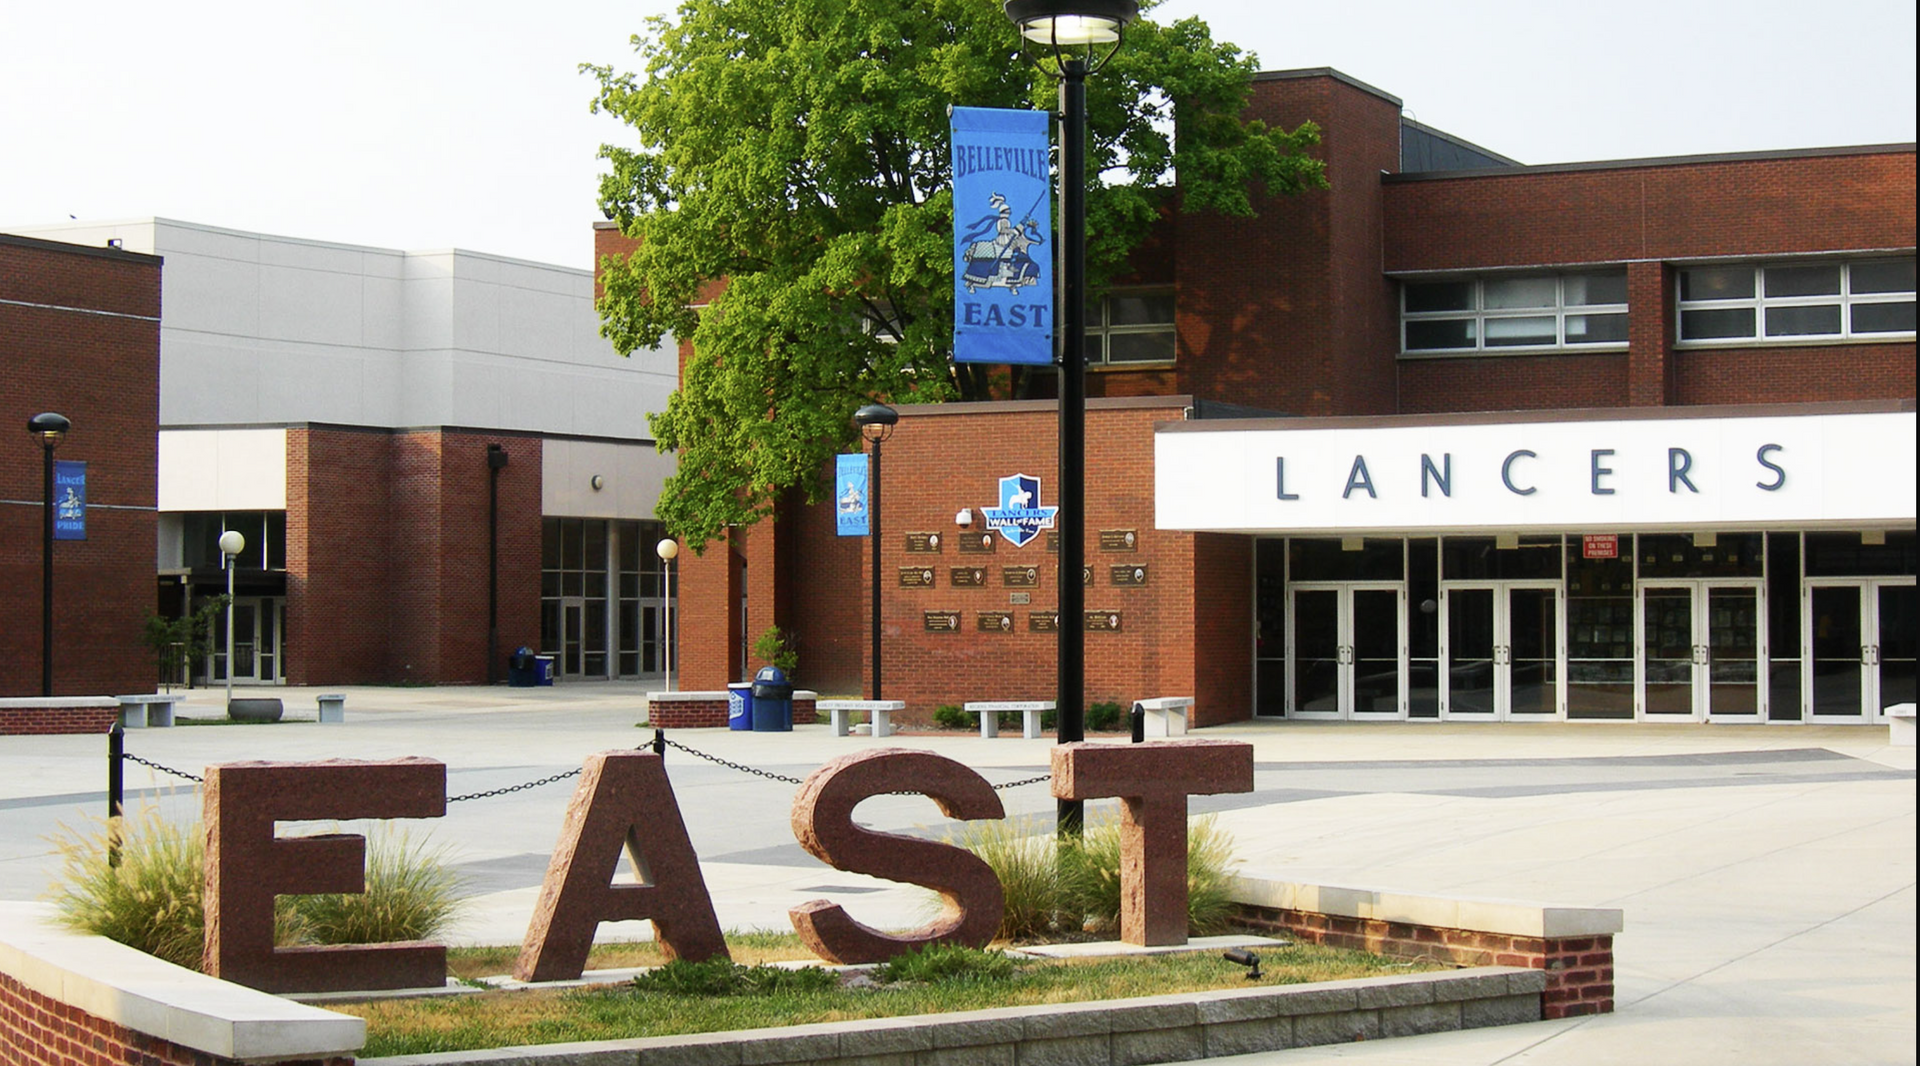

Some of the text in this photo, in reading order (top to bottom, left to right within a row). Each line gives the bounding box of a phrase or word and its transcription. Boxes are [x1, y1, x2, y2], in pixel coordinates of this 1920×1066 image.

[957, 145, 1047, 183] BELLEVILLE
[963, 302, 1048, 328] EAST
[1275, 443, 1787, 501] LANCERS
[57, 521, 84, 530] PRIDE
[840, 516, 866, 525] EAST
[990, 518, 1017, 526] WALL
[1023, 517, 1052, 526] FAME
[202, 740, 1254, 994] EAST
